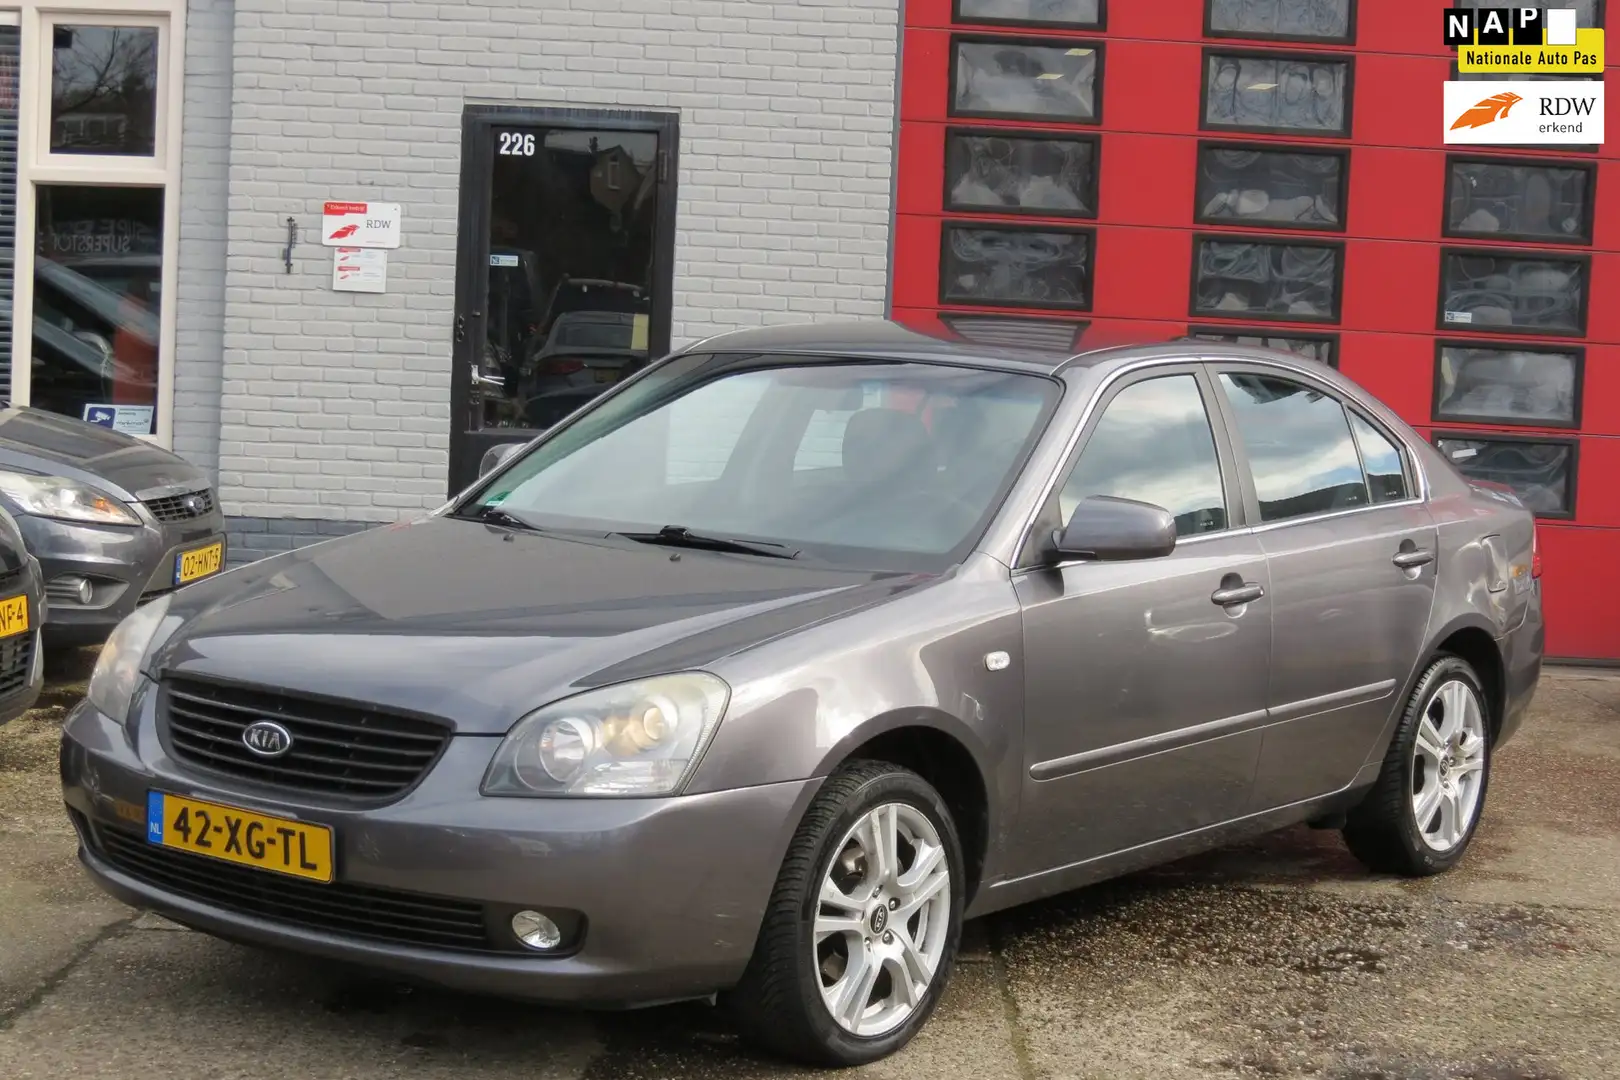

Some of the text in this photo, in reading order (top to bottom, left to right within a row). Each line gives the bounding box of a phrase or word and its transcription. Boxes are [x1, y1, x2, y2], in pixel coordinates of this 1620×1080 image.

[499, 132, 536, 157] 226
[366, 219, 392, 229] RDW
[183, 547, 219, 577] 02-HNT-5
[251, 728, 281, 751] KIA
[150, 822, 162, 834] NL
[173, 807, 317, 871] 42-XG-TL
